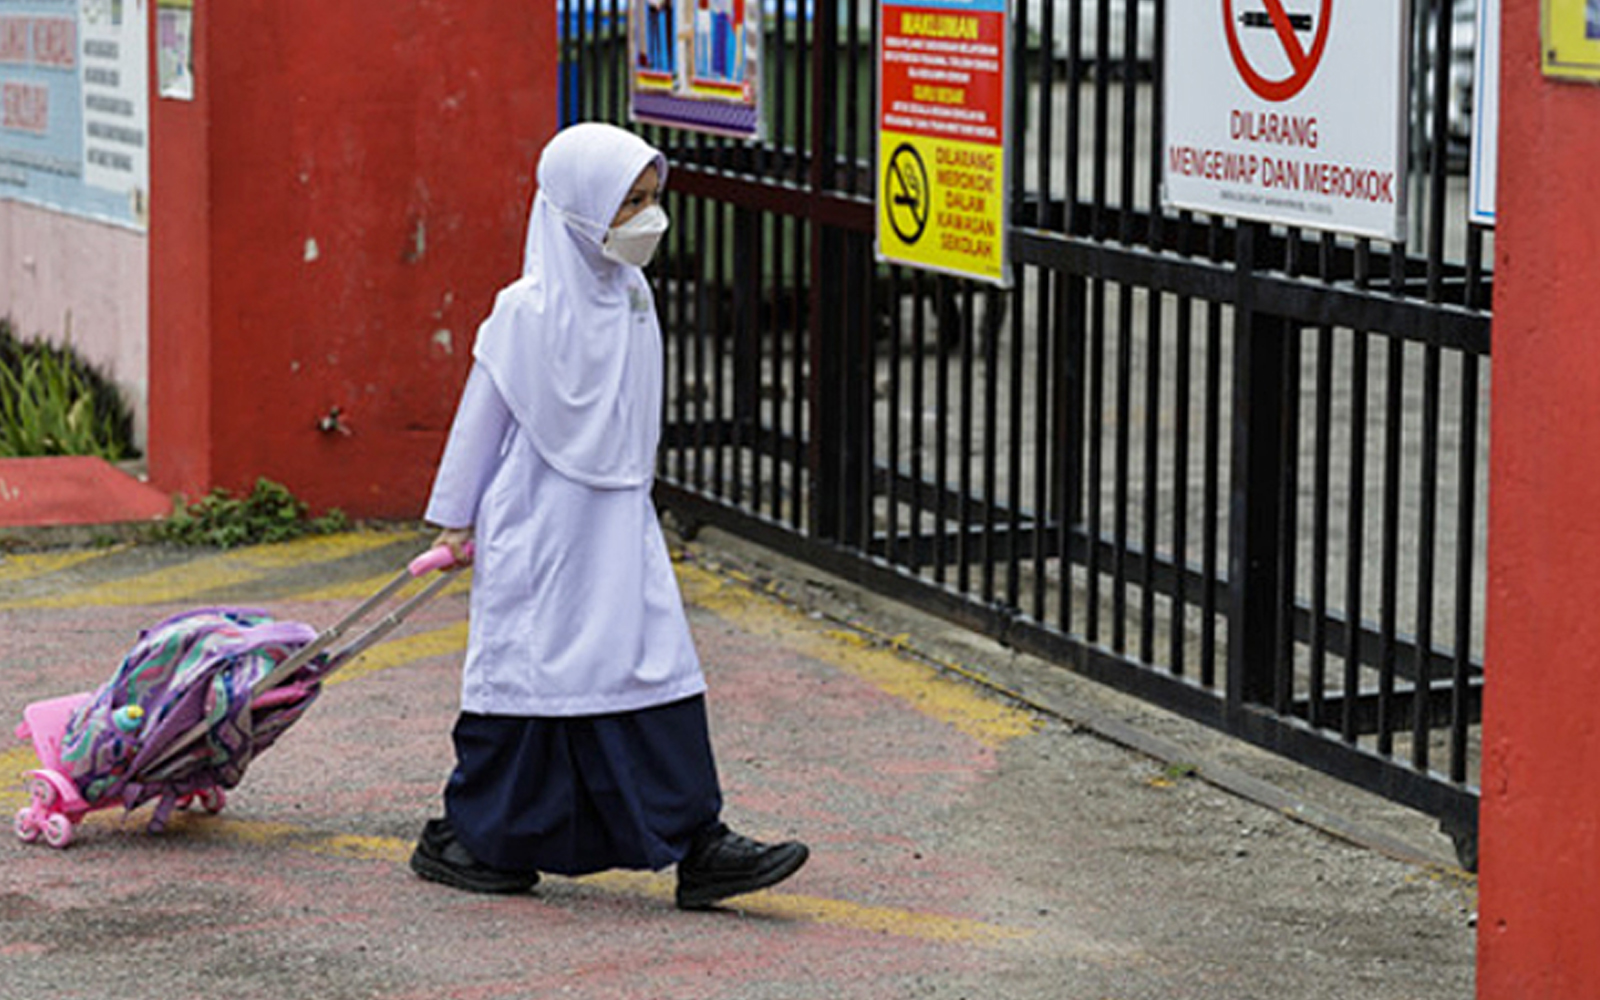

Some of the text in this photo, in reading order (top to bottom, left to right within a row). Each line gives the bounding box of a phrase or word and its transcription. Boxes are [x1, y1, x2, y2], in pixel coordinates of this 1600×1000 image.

[901, 12, 978, 39] MAKLUMAN
[1231, 109, 1318, 148] DILARANG
[936, 146, 995, 172] DILARANG
[936, 169, 995, 194] MEROKOK
[1169, 147, 1258, 183] MENGEWAP
[1262, 156, 1299, 190] DAN
[1303, 163, 1394, 203] MEROKOK
[945, 190, 986, 213] DALAM
[936, 212, 996, 236] KAWASAN
[940, 232, 992, 259] SEKOLAH
